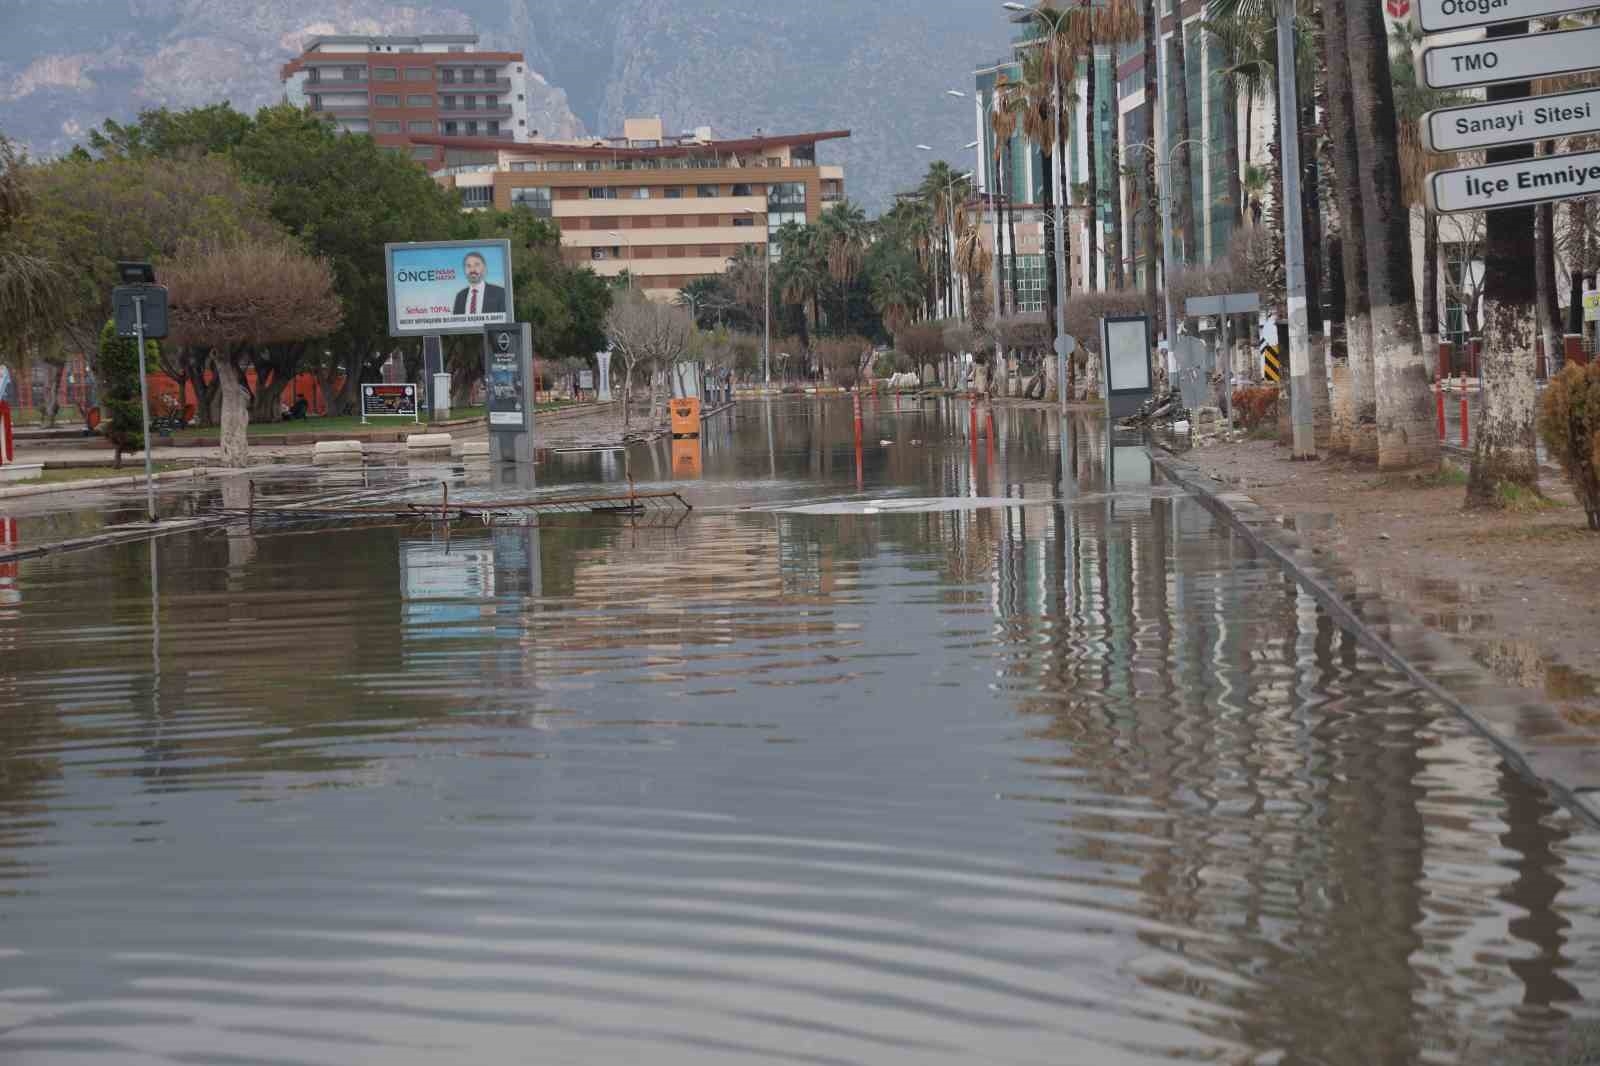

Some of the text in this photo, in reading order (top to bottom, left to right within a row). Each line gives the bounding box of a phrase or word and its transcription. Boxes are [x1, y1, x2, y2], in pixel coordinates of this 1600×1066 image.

[1441, 0, 1508, 15] Otogar
[1451, 52, 1498, 72] TMO
[1455, 102, 1591, 134] Sanayi Sitesi
[1465, 175, 1509, 198] İlçe
[397, 269, 435, 282] ÖNCE
